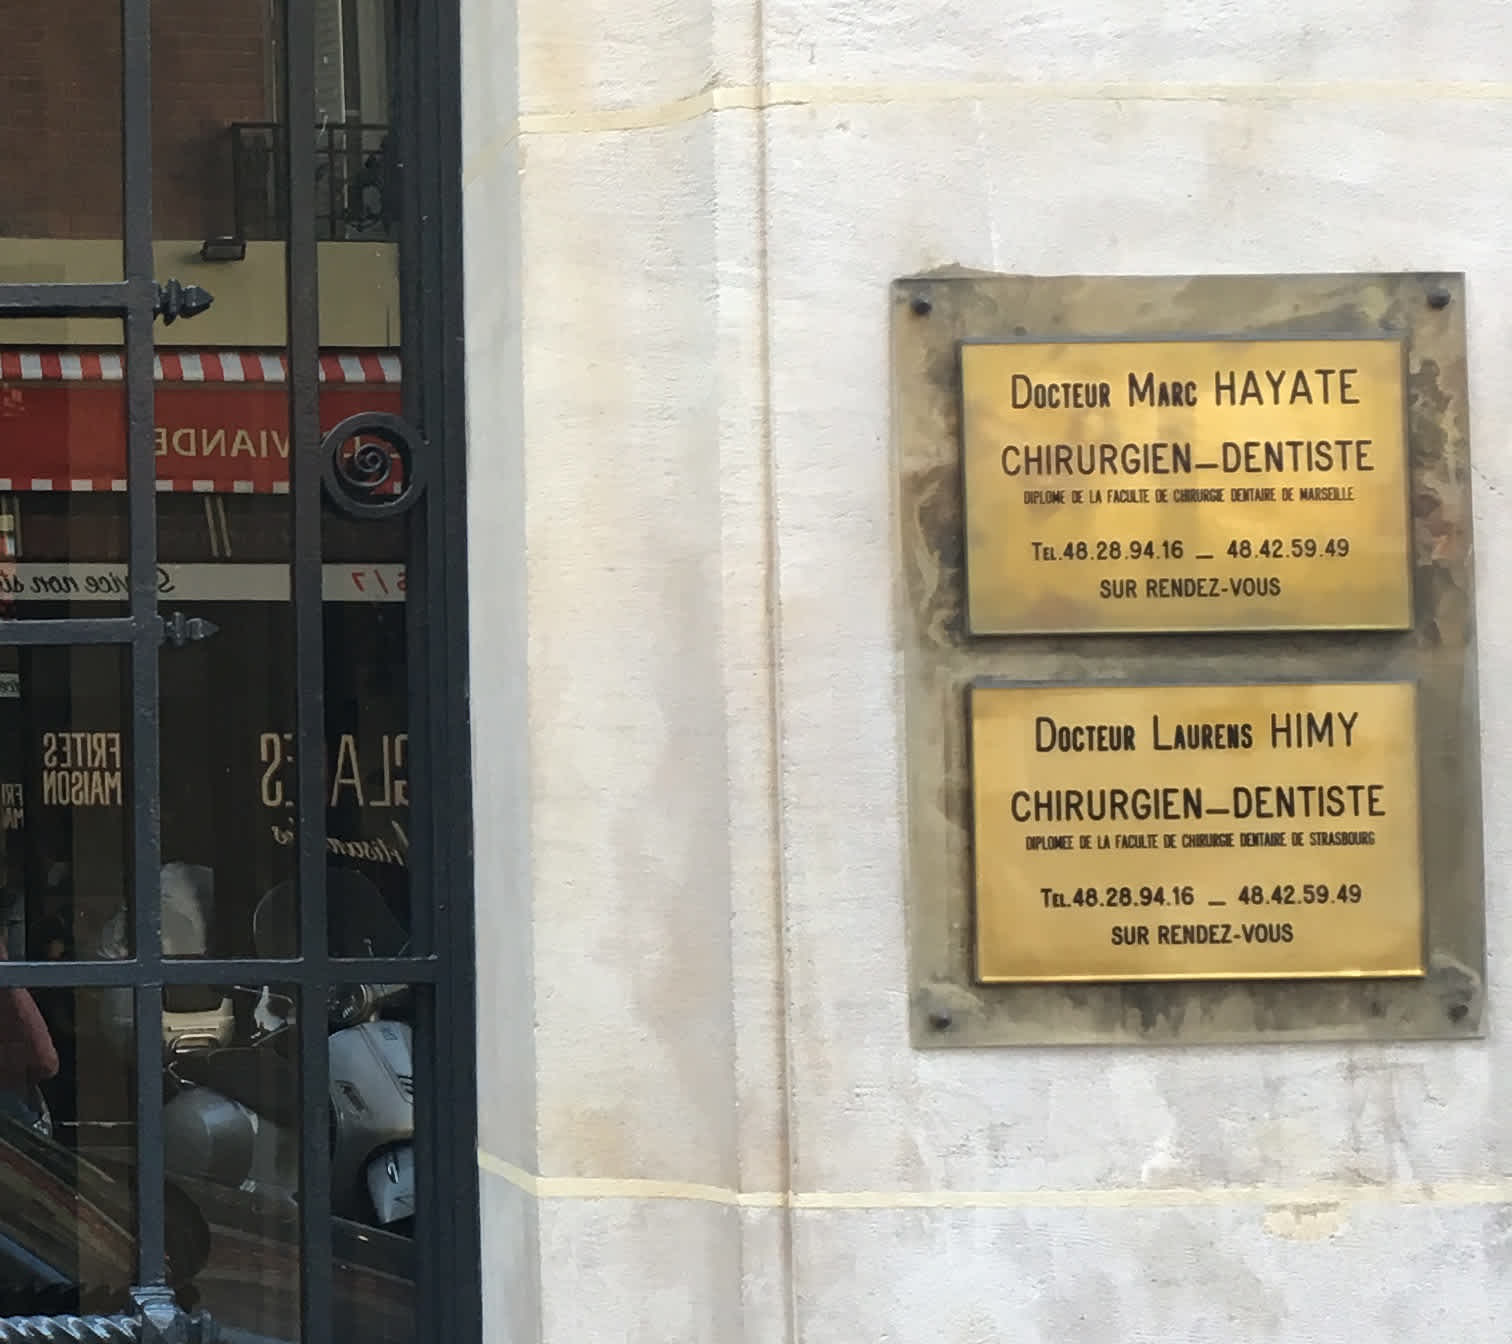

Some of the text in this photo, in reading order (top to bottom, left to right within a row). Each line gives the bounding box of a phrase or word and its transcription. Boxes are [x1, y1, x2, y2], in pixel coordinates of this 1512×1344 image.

[1214, 368, 1361, 406] HAYATE
[1072, 489, 1083, 504] DE
[1090, 489, 1102, 503] LA
[1107, 489, 1149, 504] FACULTE
[1155, 489, 1168, 503] DE
[1231, 488, 1276, 502] DENTAIRE
[1282, 487, 1293, 501] DE
[1300, 486, 1354, 501] MARSEILLE
[1226, 539, 1350, 558] 48.42.59.49
[1100, 577, 1281, 599] SUR RENDEZ-VOUS
[1271, 712, 1359, 748] HIMY
[1080, 835, 1092, 849] DE
[1097, 835, 1110, 849] LA
[1115, 834, 1158, 848] FACULTE
[1163, 834, 1177, 848] DE
[1240, 832, 1287, 847] DENTAIRE
[1292, 832, 1304, 846] DE
[1310, 831, 1375, 846] STRASBOURG
[1238, 885, 1362, 904] 48.42.59.49
[1111, 923, 1294, 946] SUR RENDEZ-VOUS
